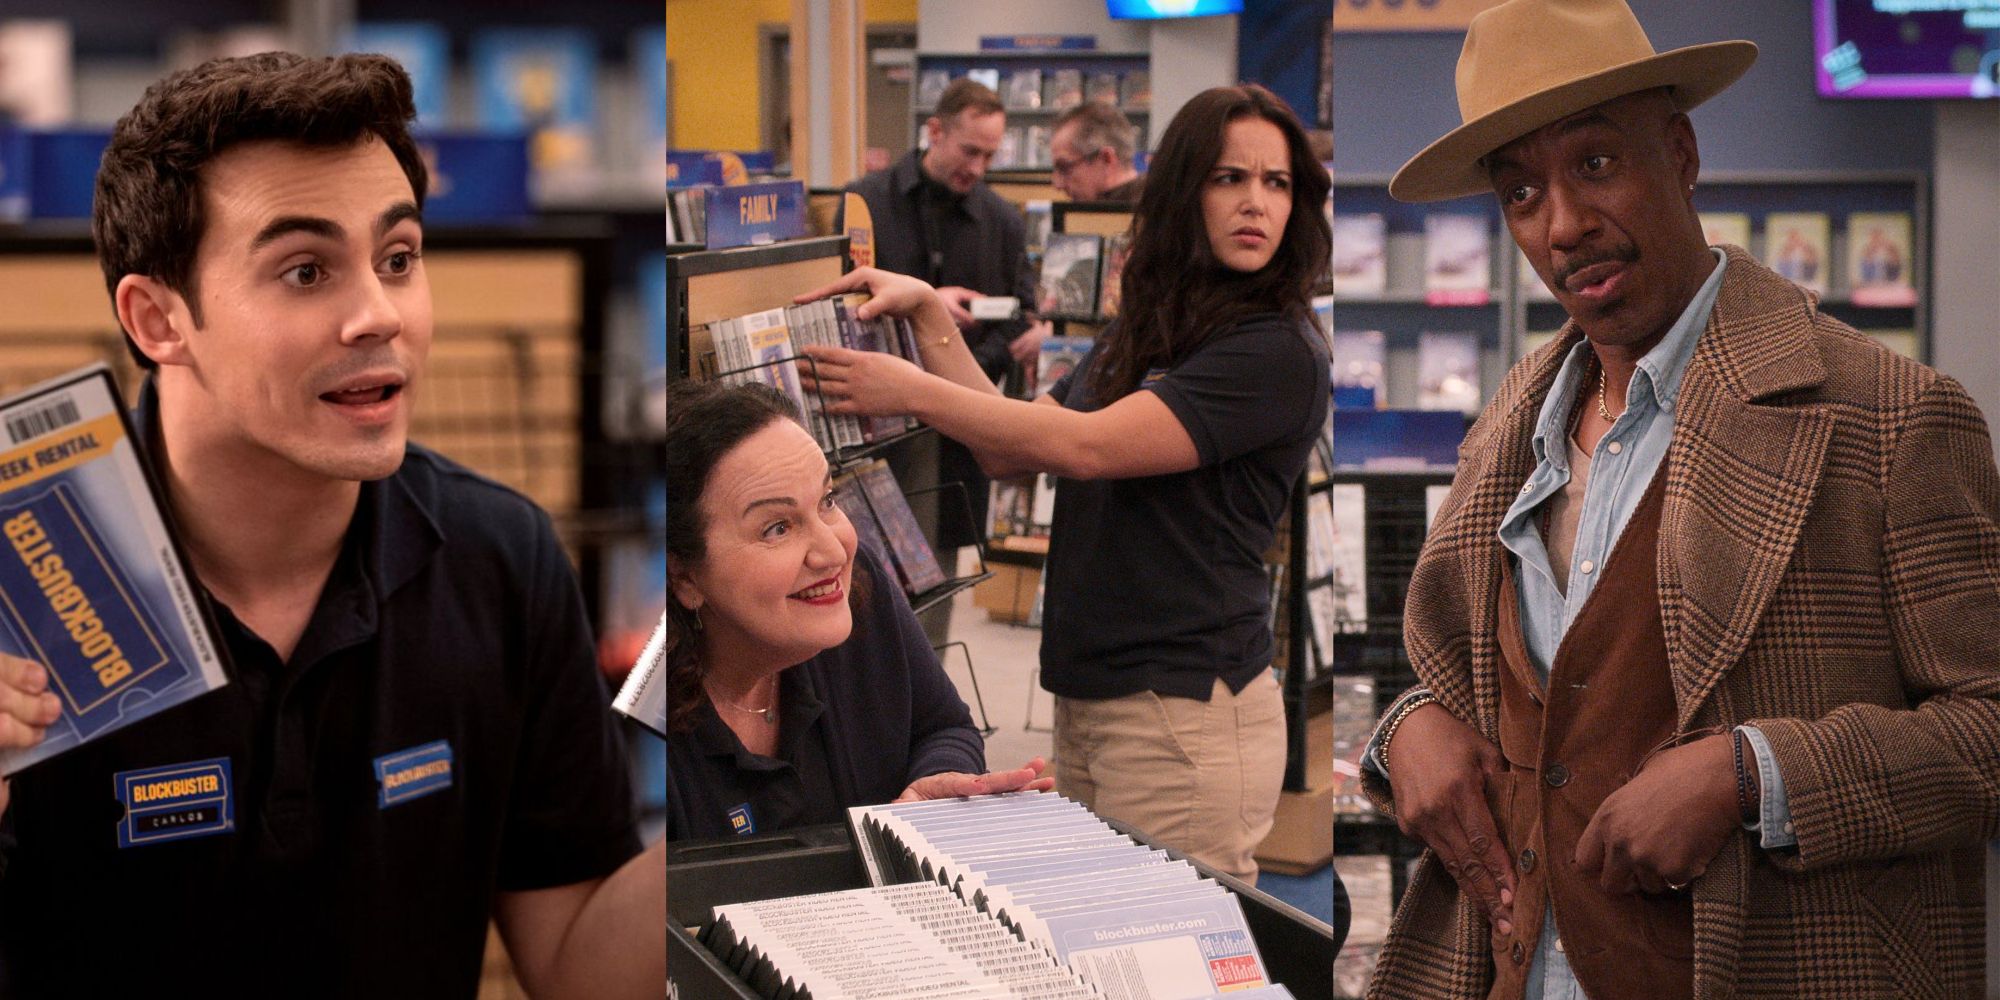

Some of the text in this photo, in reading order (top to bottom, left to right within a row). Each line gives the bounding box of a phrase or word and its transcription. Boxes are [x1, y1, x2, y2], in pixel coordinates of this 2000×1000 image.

[739, 193, 778, 225] FAMILY
[0, 433, 100, 480] EEK RENTAL
[3, 509, 132, 688] BLOCKBUSTER
[133, 775, 219, 802] BLOCKBUSTER
[153, 812, 203, 828] CARLOS
[1094, 917, 1207, 941] blockbuster.com
